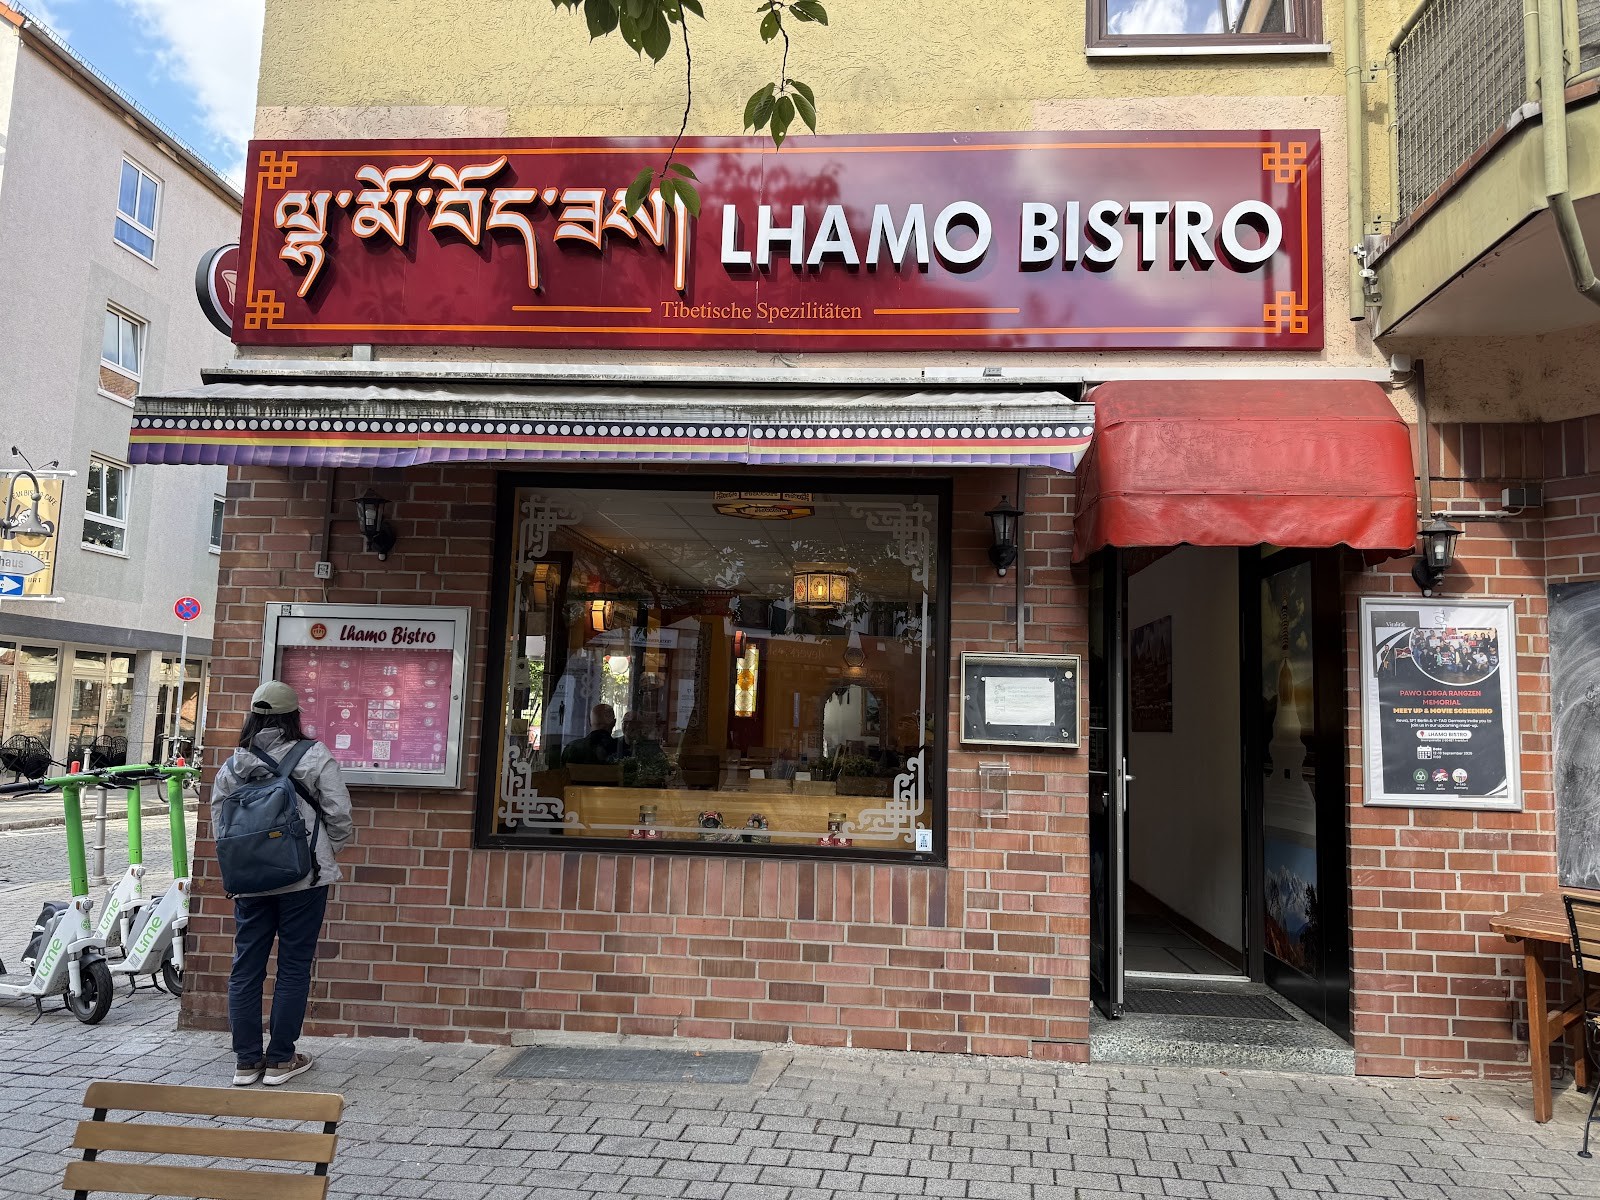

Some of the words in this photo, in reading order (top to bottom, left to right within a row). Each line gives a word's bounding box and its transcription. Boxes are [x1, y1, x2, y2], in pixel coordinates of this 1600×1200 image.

[720, 200, 993, 269] LHAMO
[1019, 199, 1284, 269] BISTRO
[660, 301, 752, 320] Tibetische
[756, 302, 863, 323] Spezilitäten
[340, 625, 388, 644] Lhamo
[391, 626, 436, 645] Bistro
[101, 898, 120, 930] Lime
[135, 916, 162, 954] Lime
[40, 938, 62, 977] Lime
